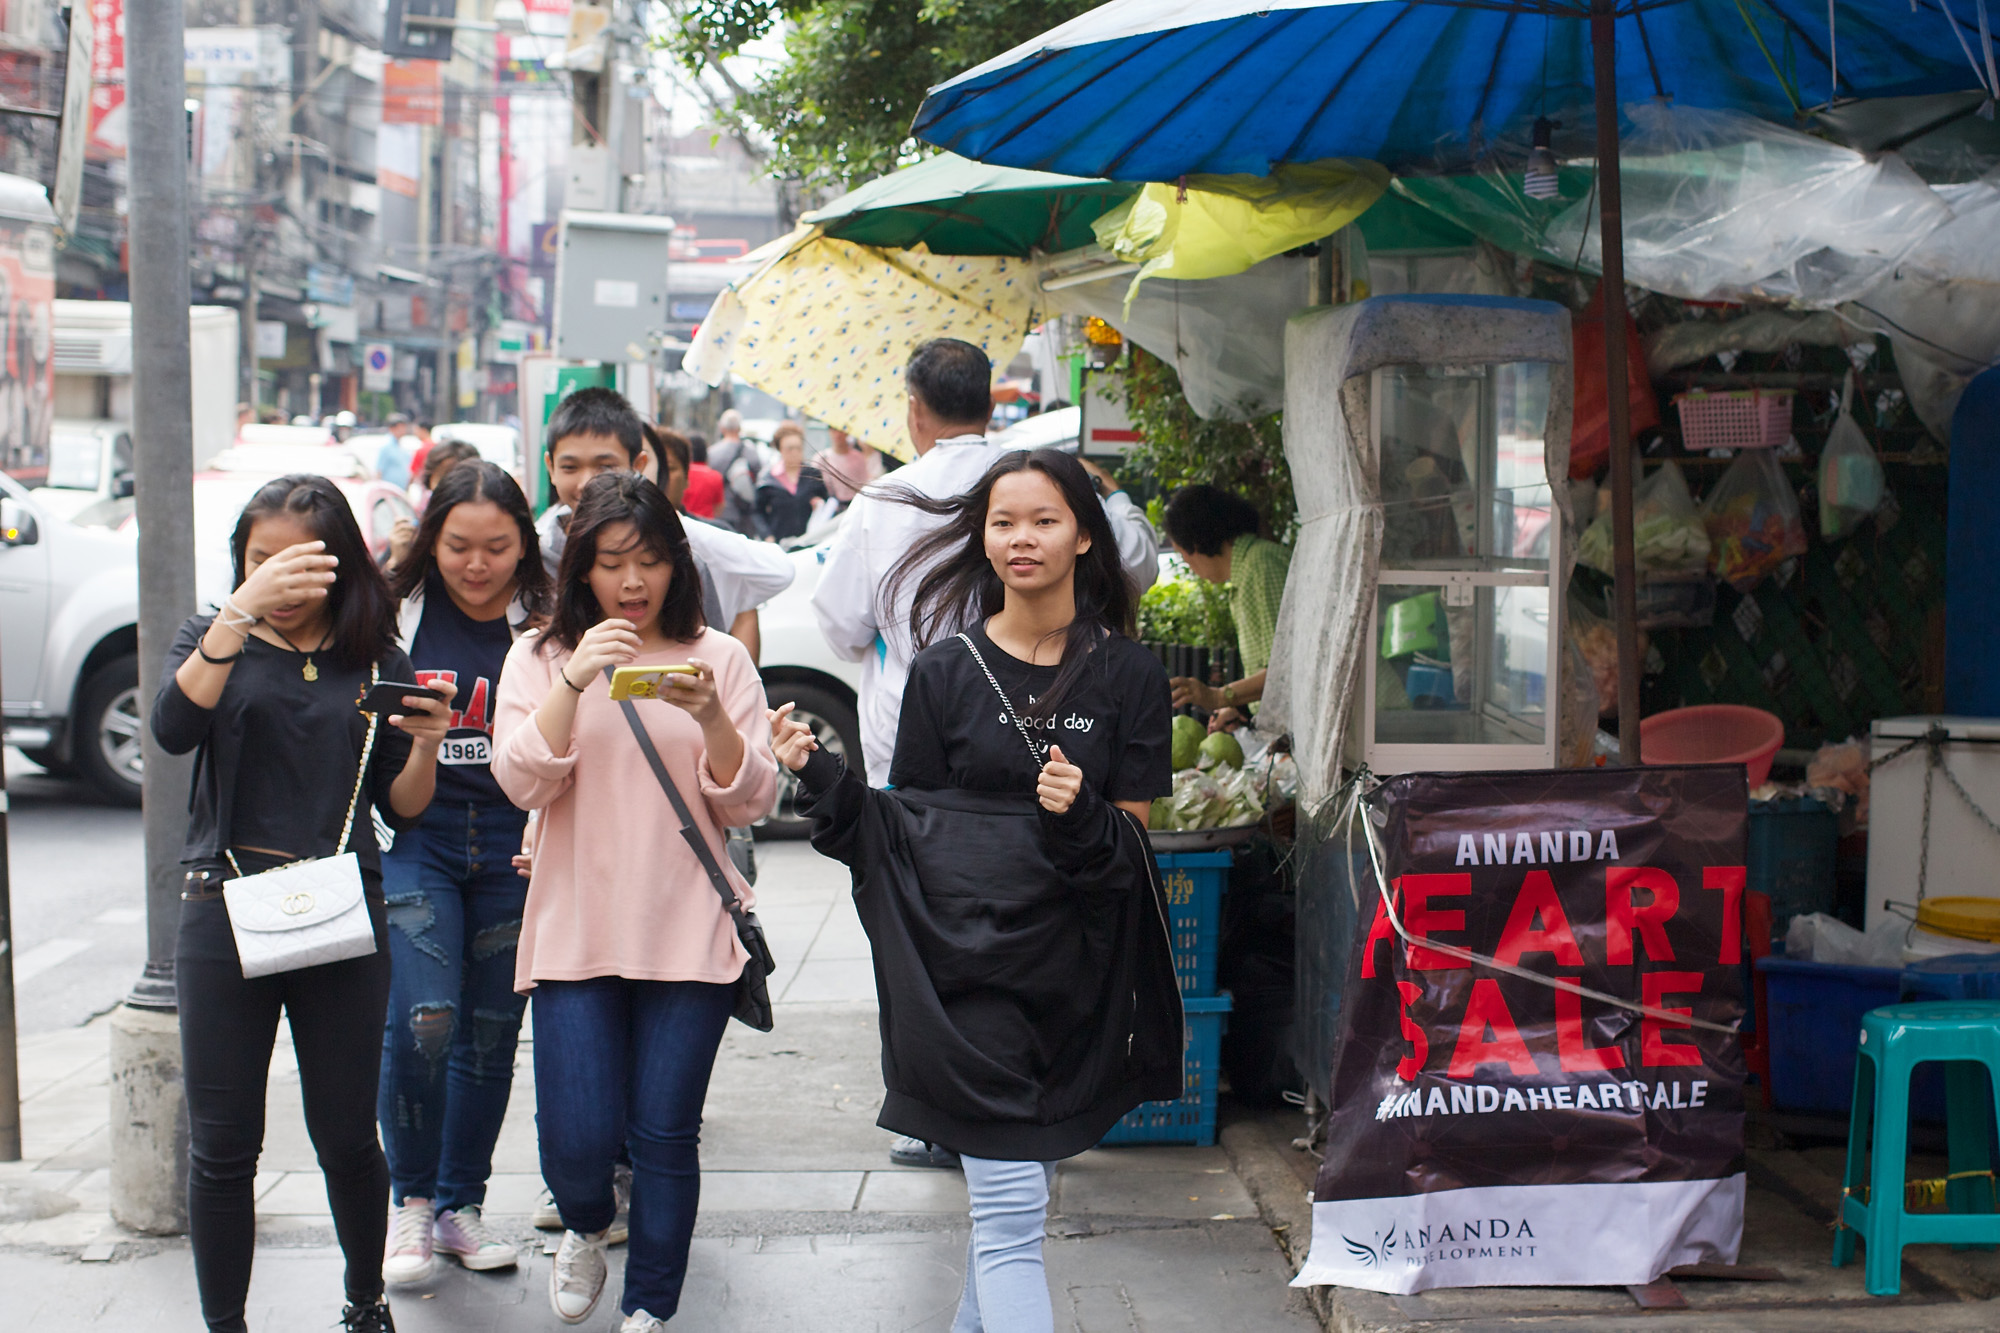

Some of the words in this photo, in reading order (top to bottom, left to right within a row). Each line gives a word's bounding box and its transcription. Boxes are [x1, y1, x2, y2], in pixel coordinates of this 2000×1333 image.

[998, 712, 1008, 725] a
[1063, 712, 1095, 733] day
[443, 742, 488, 760] 1982
[1455, 829, 1620, 867] ANANDA
[1396, 971, 1704, 1082] SALE
[1404, 1218, 1536, 1250] ANANDA
